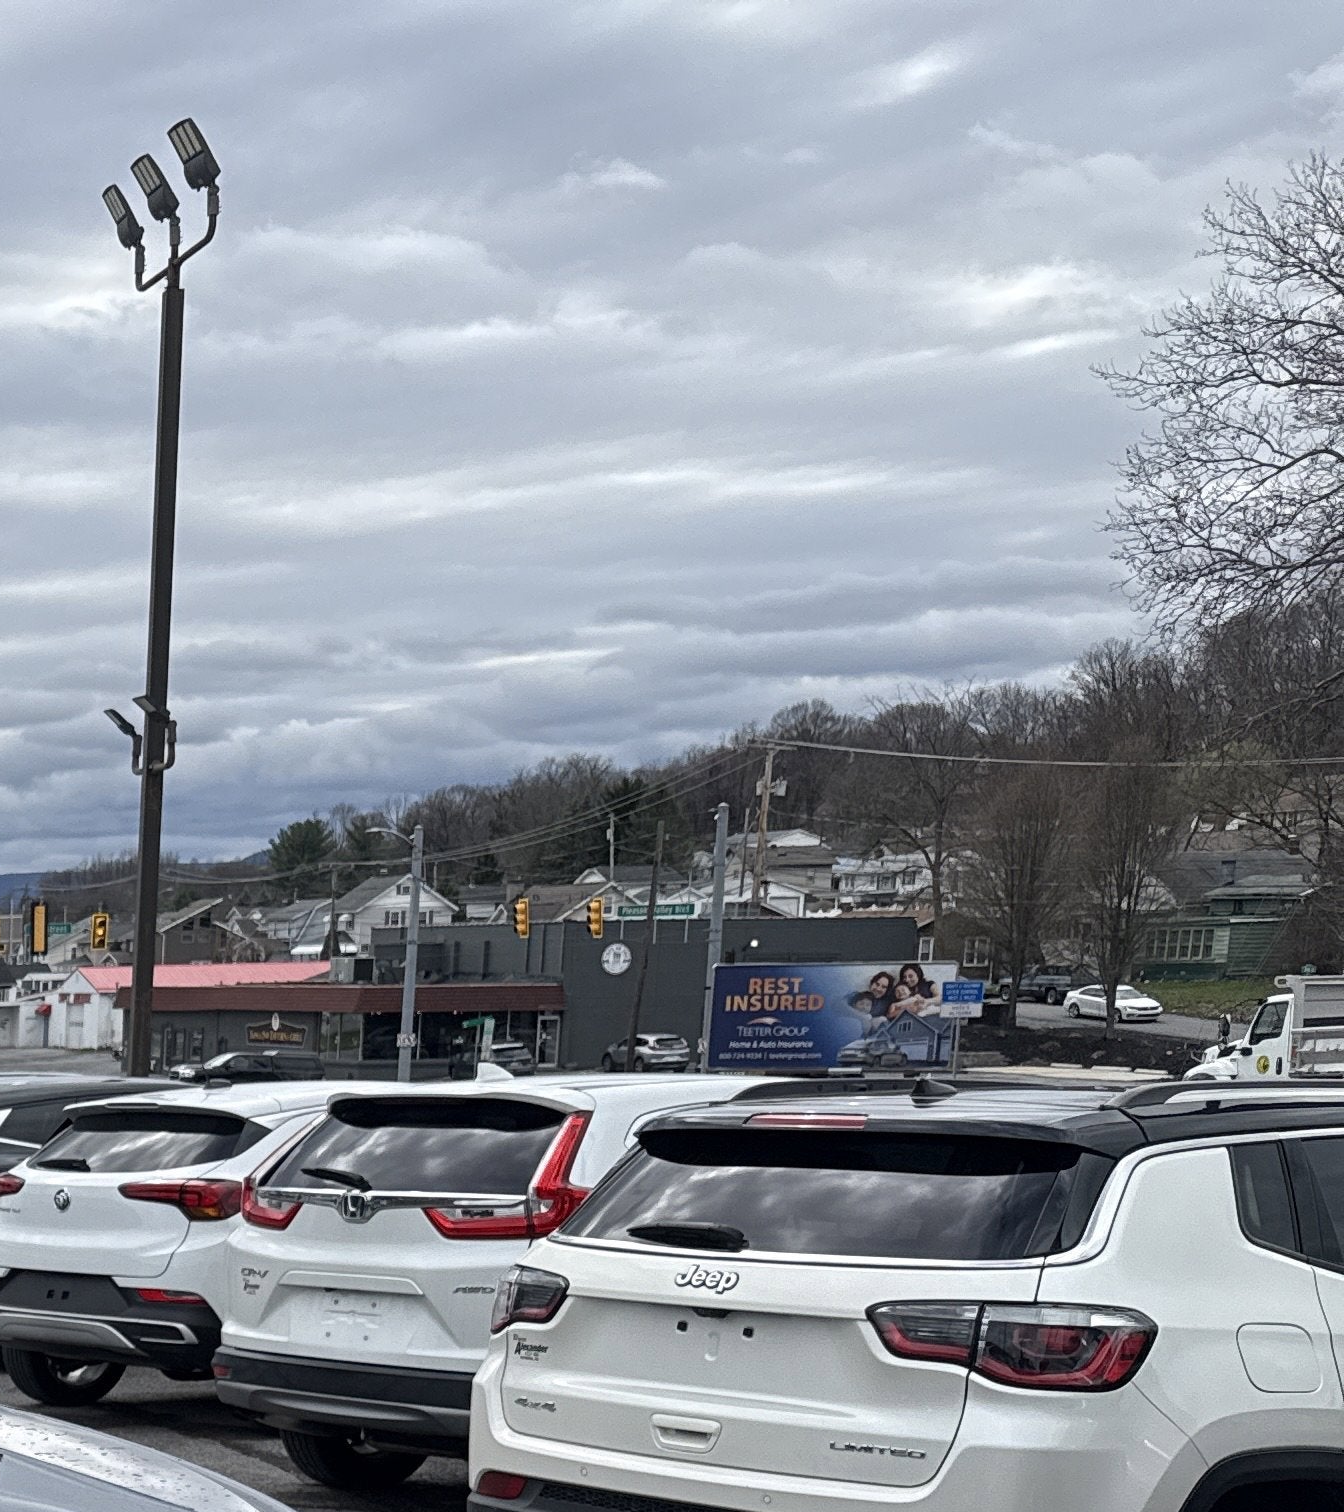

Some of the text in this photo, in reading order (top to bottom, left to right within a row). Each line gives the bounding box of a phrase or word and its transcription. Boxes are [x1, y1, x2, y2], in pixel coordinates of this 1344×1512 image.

[748, 977, 803, 995] REST
[725, 994, 825, 1012] INSURED
[736, 1026, 810, 1037] TEETER GROUP
[729, 1041, 751, 1050] Home
[759, 1041, 777, 1049] Auto
[778, 1041, 814, 1049] Insurance
[675, 1264, 739, 1295] Jeep
[830, 1440, 926, 1460] LIMITED
